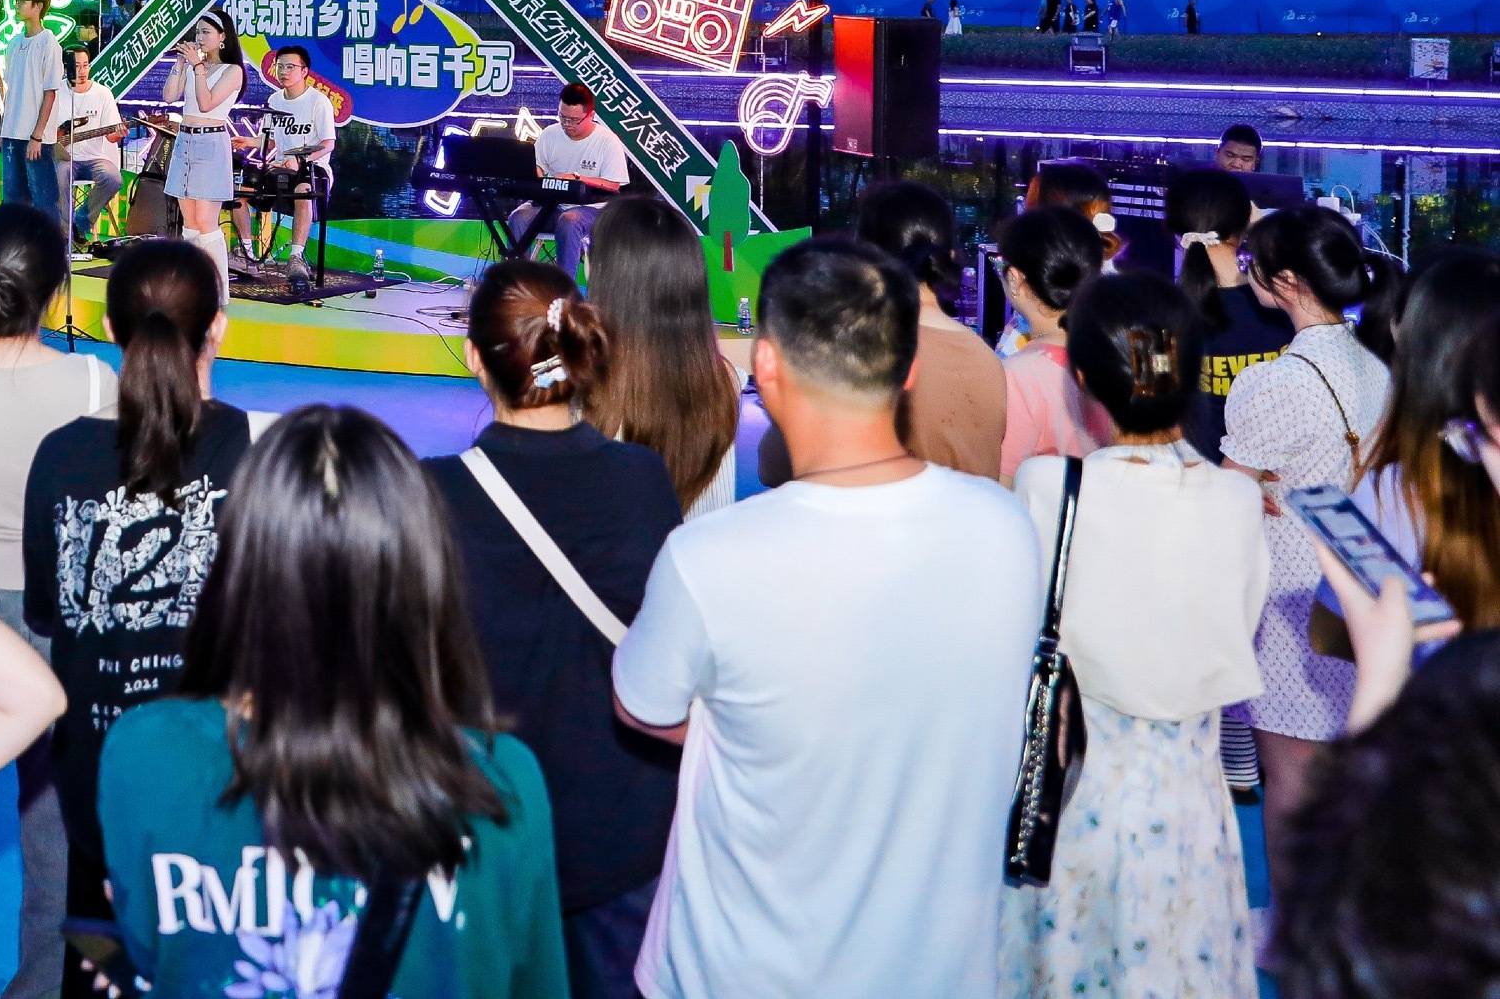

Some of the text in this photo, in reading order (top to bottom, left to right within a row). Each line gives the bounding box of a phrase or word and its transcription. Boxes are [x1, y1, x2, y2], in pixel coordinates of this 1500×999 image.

[342, 43, 512, 94] 唱响百千万
[541, 178, 569, 192] KORG
[130, 654, 184, 673] CHING
